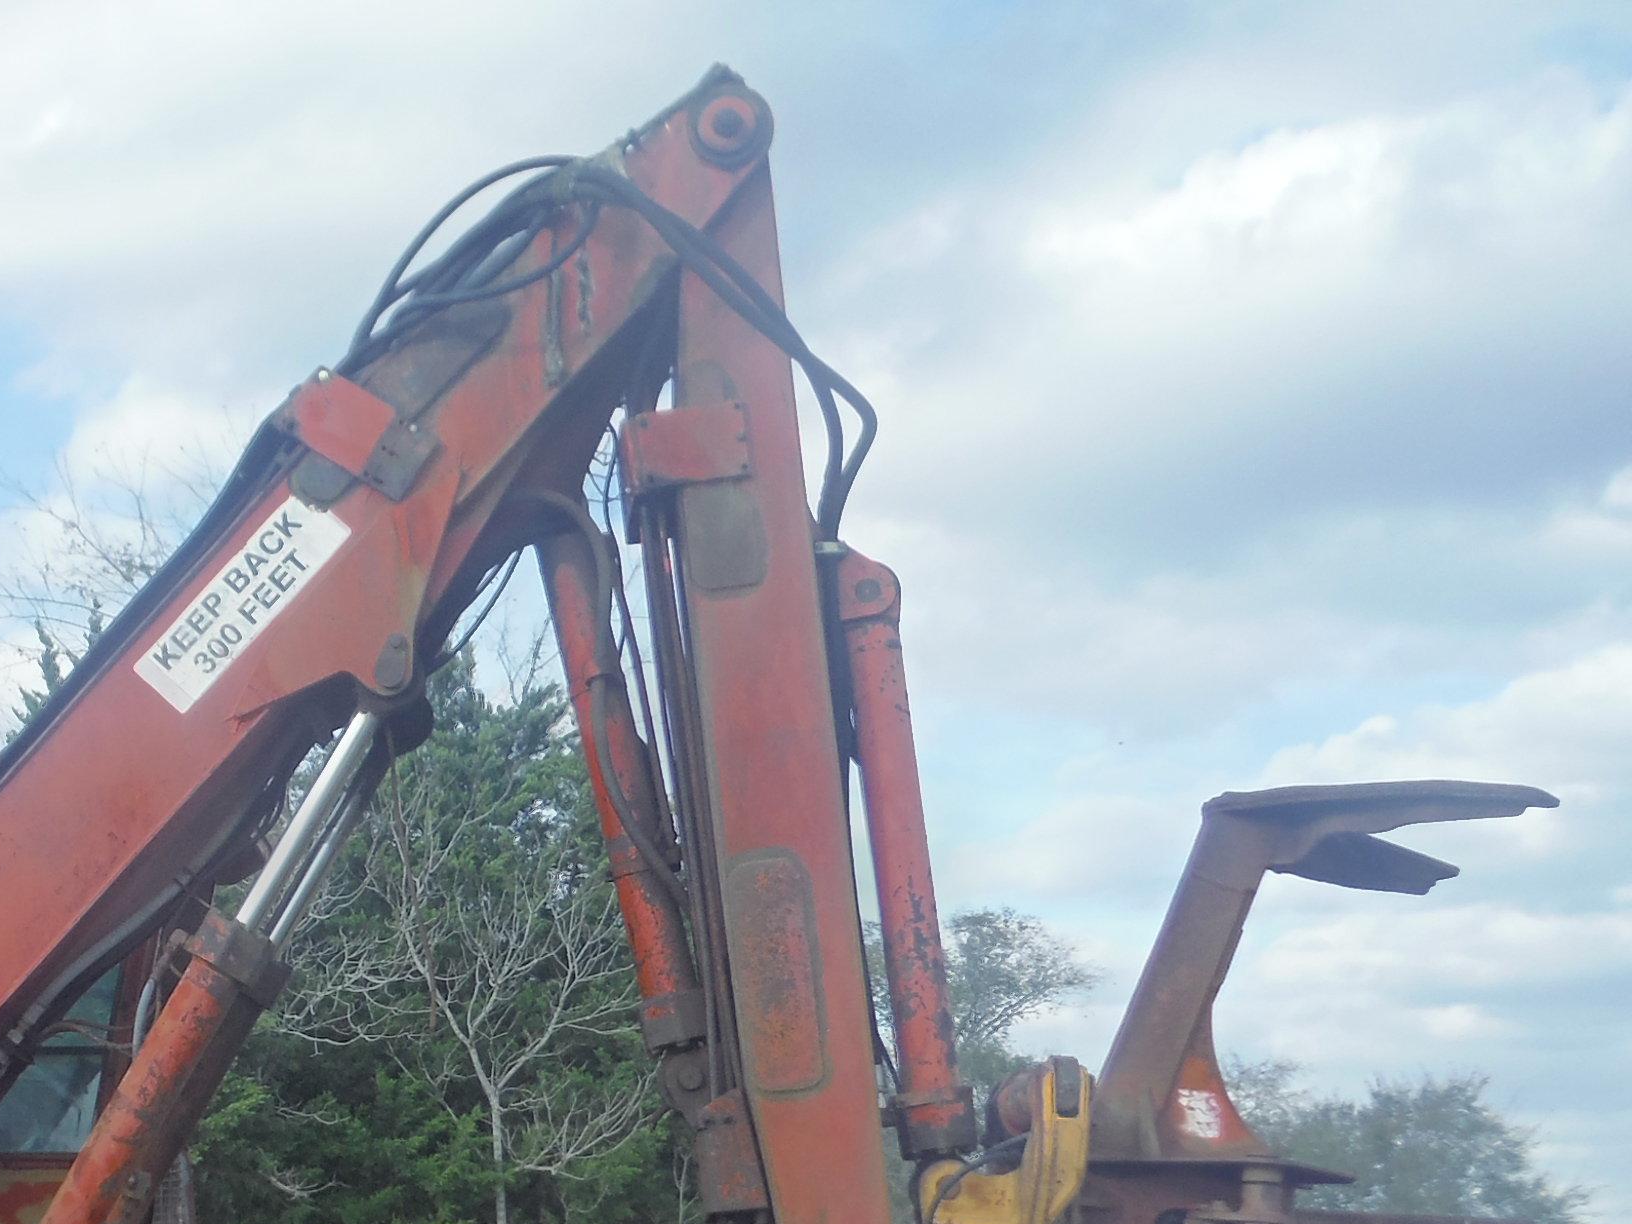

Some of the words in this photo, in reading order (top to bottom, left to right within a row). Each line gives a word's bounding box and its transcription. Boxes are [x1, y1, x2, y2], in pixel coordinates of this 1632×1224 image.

[152, 592, 222, 670] KEEP
[223, 512, 302, 594] BACK
[194, 623, 243, 674] 300
[237, 549, 307, 625] FEET
